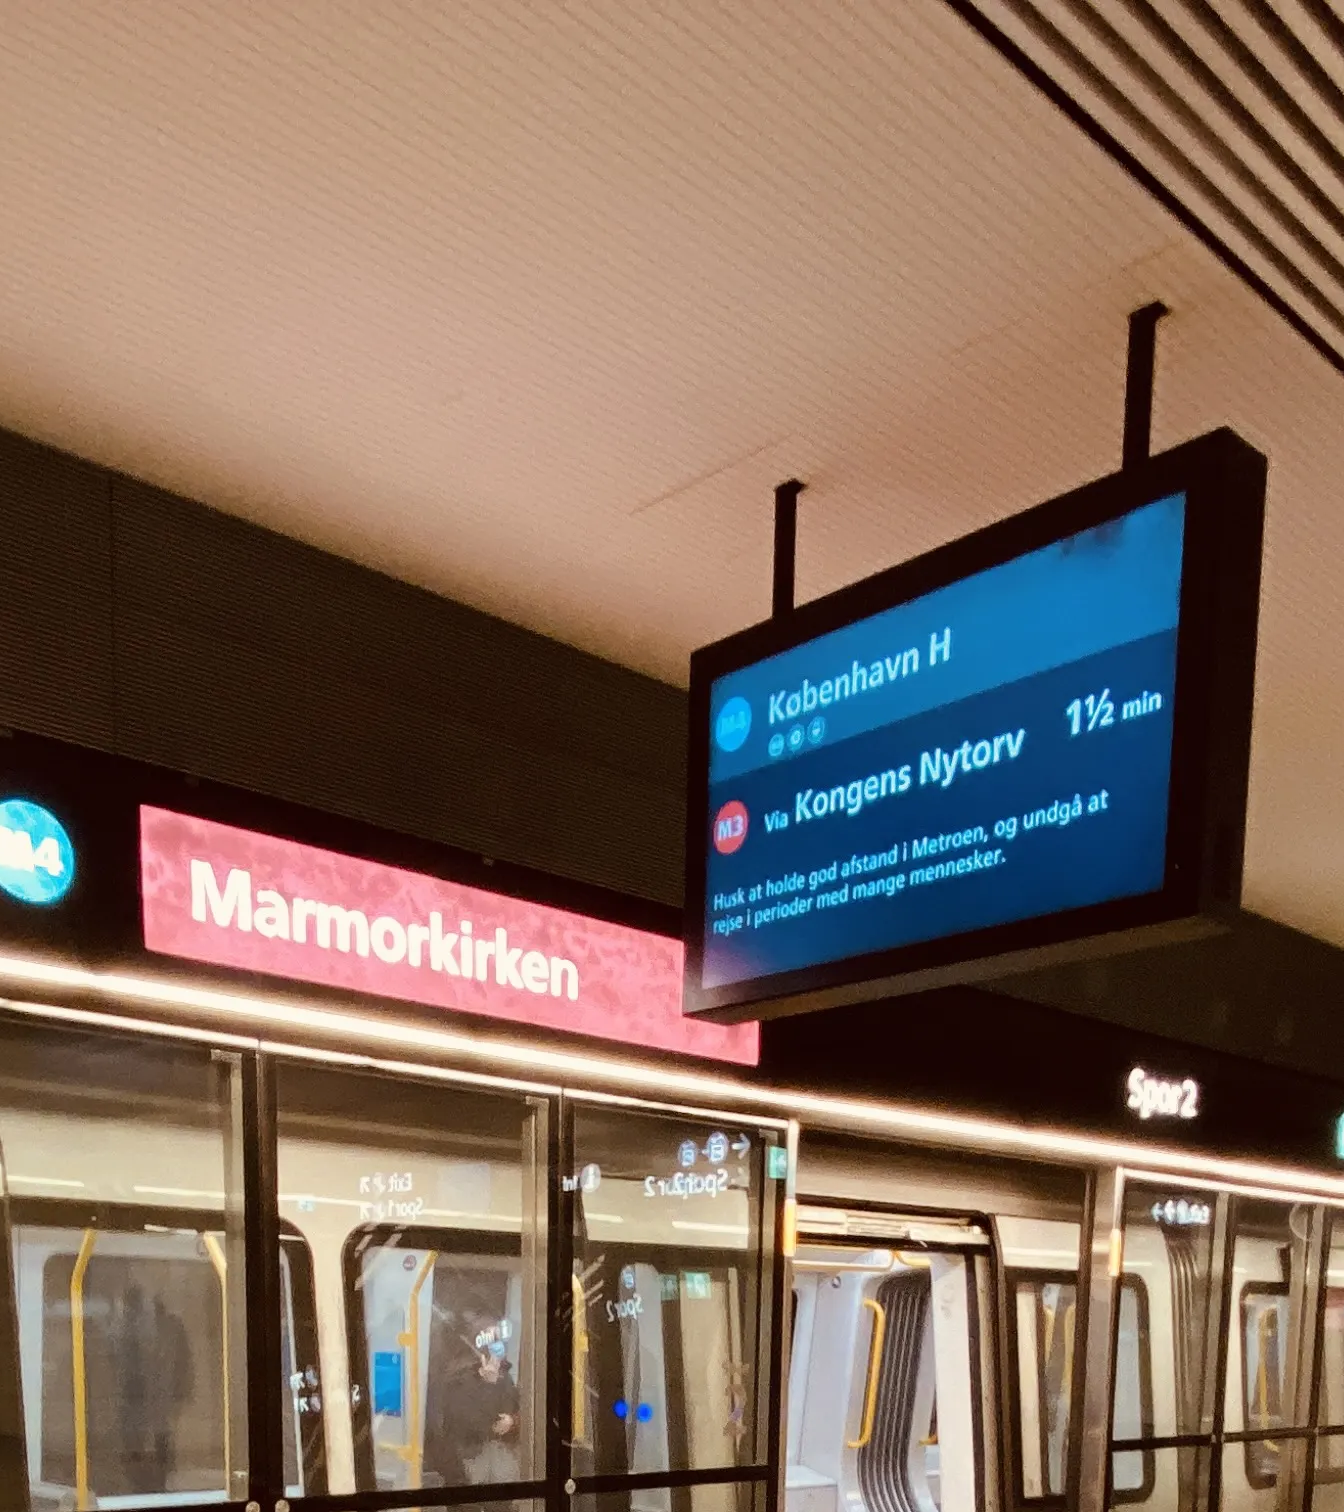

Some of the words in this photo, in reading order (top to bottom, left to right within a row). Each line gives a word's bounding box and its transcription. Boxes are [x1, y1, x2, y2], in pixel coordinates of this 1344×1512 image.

[768, 647, 919, 725] København
[929, 627, 951, 666] H
[1066, 688, 1115, 736] 1½
[1122, 691, 1162, 719] min
[718, 815, 745, 841] M3
[764, 810, 789, 833] Via
[795, 764, 911, 824] Kongens
[919, 728, 1026, 788] Nytorv
[713, 915, 743, 936] rejse
[754, 897, 812, 928] perioder
[816, 884, 849, 910] med
[853, 872, 905, 899] mange
[909, 848, 1006, 885] mennesker.
[714, 887, 744, 911] Husk
[749, 883, 762, 902] at
[766, 872, 805, 897] holde
[809, 861, 837, 890] god
[841, 844, 898, 877] afstand
[912, 826, 988, 859] Metroen,
[994, 817, 1017, 839] og
[1023, 793, 1082, 825] undgå
[1088, 789, 1109, 813] at
[190, 859, 579, 1001] Marmorkirken
[1127, 1067, 1182, 1119] Spor
[1180, 1079, 1198, 1118] 2
